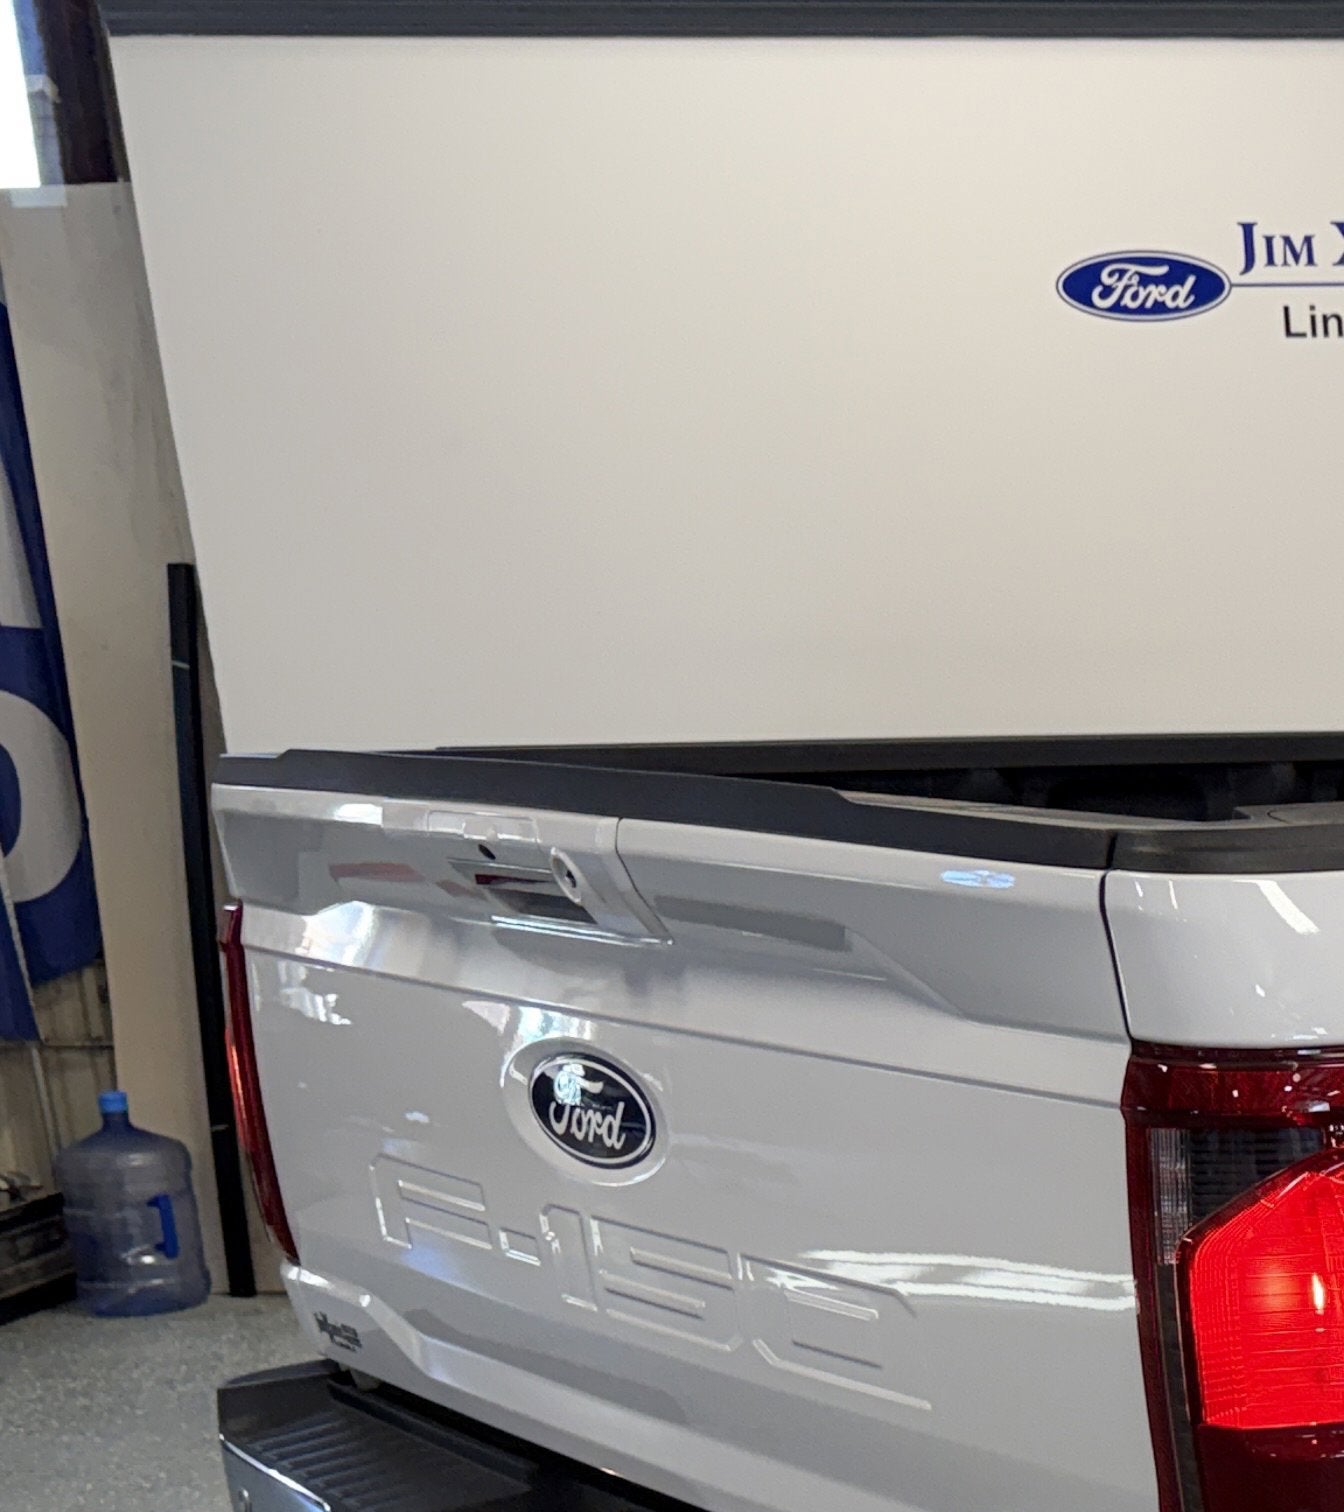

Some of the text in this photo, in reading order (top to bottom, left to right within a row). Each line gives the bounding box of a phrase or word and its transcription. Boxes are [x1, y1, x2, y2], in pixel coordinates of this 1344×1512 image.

[1236, 221, 1319, 276] JIM
[1090, 262, 1196, 312] Ford
[550, 1063, 626, 1150] Ford
